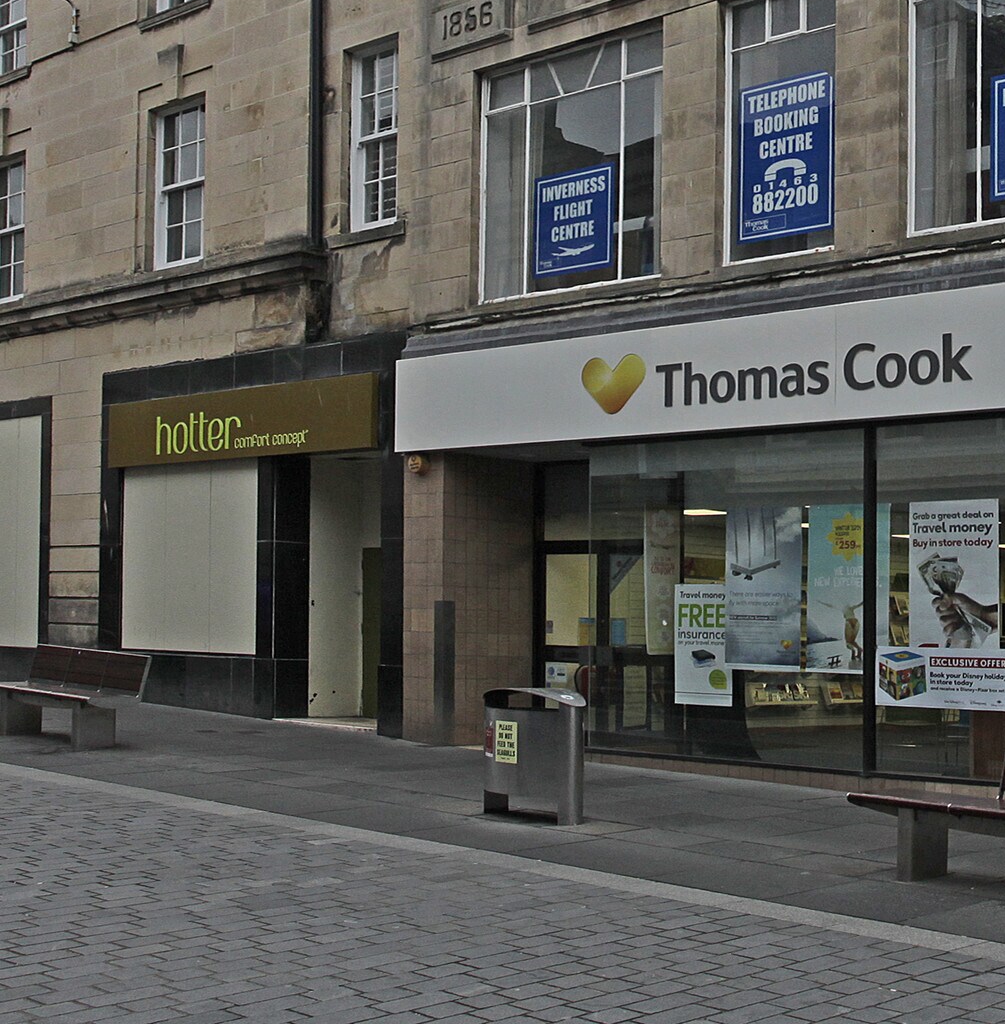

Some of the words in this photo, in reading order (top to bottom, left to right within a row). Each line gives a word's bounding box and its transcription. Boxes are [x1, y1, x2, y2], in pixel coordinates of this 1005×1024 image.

[443, 1, 493, 41] 1856
[748, 79, 826, 114] TELEPHONE
[753, 106, 819, 137] BOOKING
[759, 132, 813, 159] CENTRE
[542, 175, 606, 203] INVERNESS
[752, 183, 819, 214] 882200
[553, 199, 593, 221] FLIGHT
[551, 220, 594, 243] CENTRE
[656, 360, 830, 408] Thomas
[843, 333, 973, 391] Cook
[156, 411, 241, 455] hotter
[234, 433, 270, 449] comfort
[912, 512, 930, 520] Grab
[938, 512, 960, 521] great
[962, 511, 982, 519] deal
[912, 522, 947, 534] Travel
[949, 523, 993, 535] money
[912, 539, 928, 549] Buy
[929, 538, 937, 547] in
[938, 538, 962, 547] store
[964, 538, 993, 548] today
[702, 592, 725, 600] money
[678, 604, 725, 627] FREE
[678, 628, 725, 639] insurance
[931, 658, 979, 667] EXCLUSIVE
[954, 679, 973, 687] today
[962, 672, 983, 680] Disney
[499, 723, 513, 731] PLEASE
